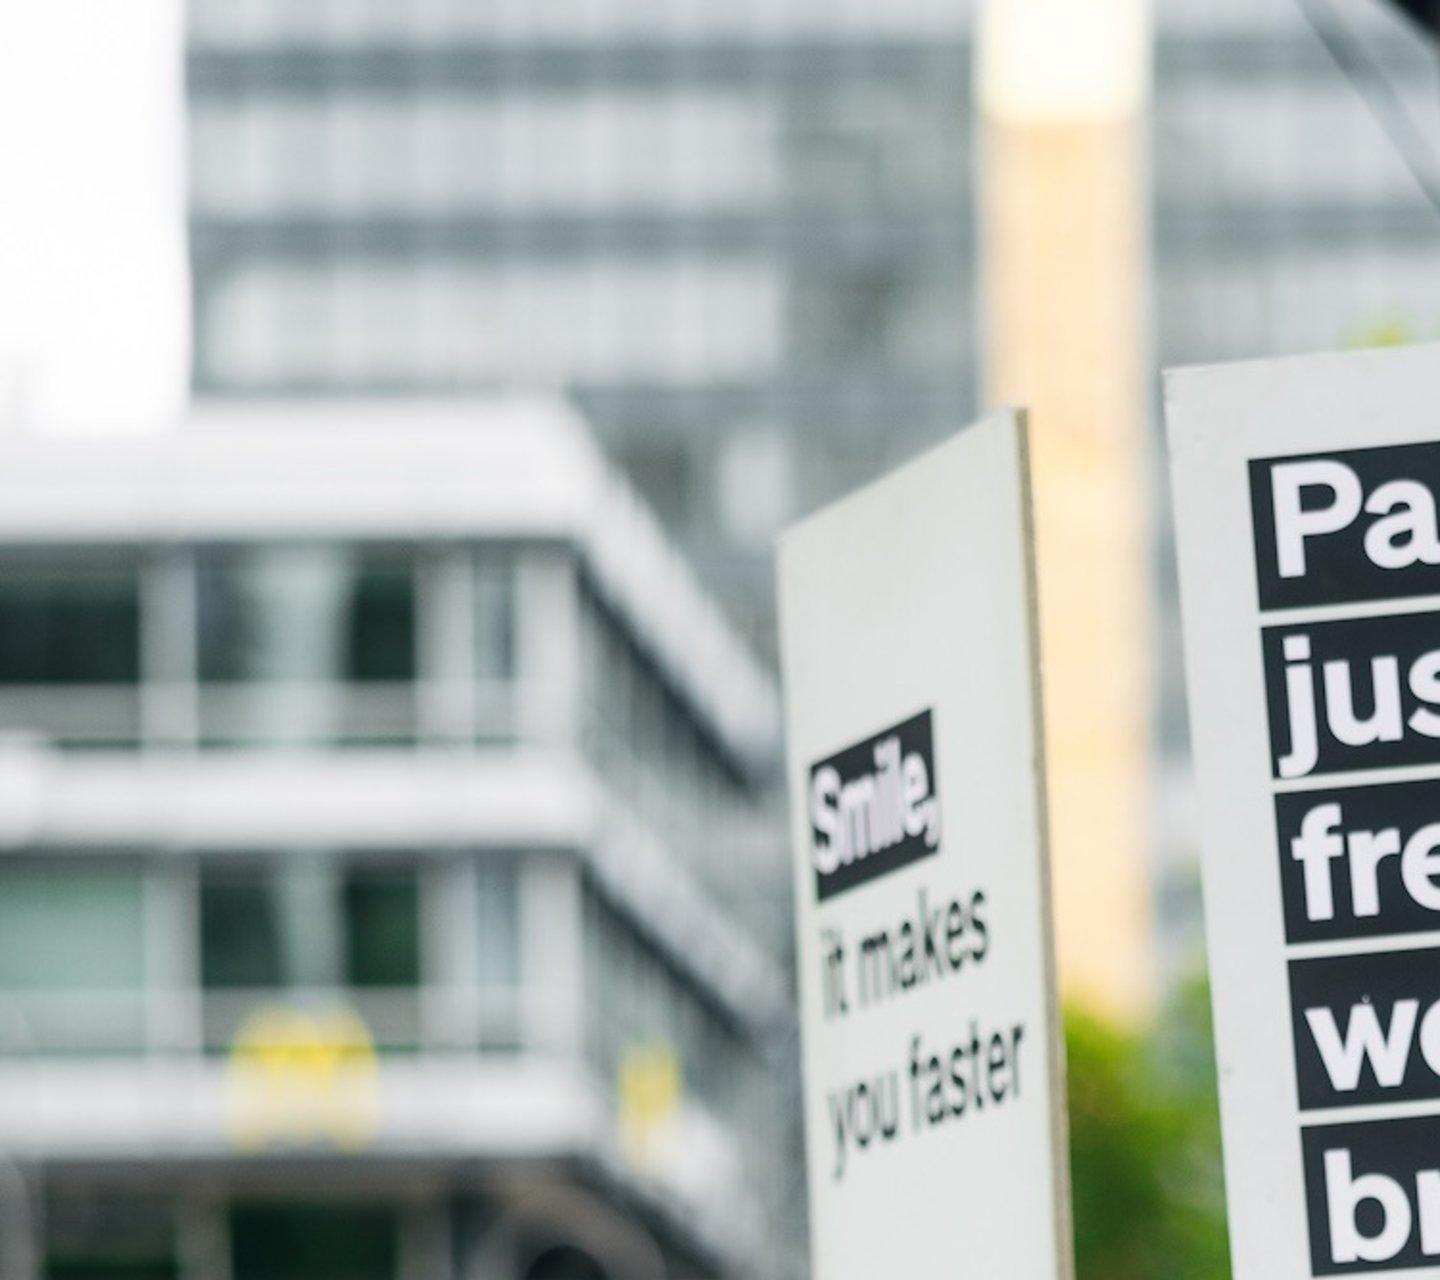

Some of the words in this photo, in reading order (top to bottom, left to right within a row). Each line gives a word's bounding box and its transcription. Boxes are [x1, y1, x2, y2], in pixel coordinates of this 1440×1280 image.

[812, 736, 940, 874] Smile,
[820, 929, 850, 1019] it
[857, 888, 990, 1006] makes
[829, 1074, 899, 1180] you
[908, 1020, 1025, 1131] faster
